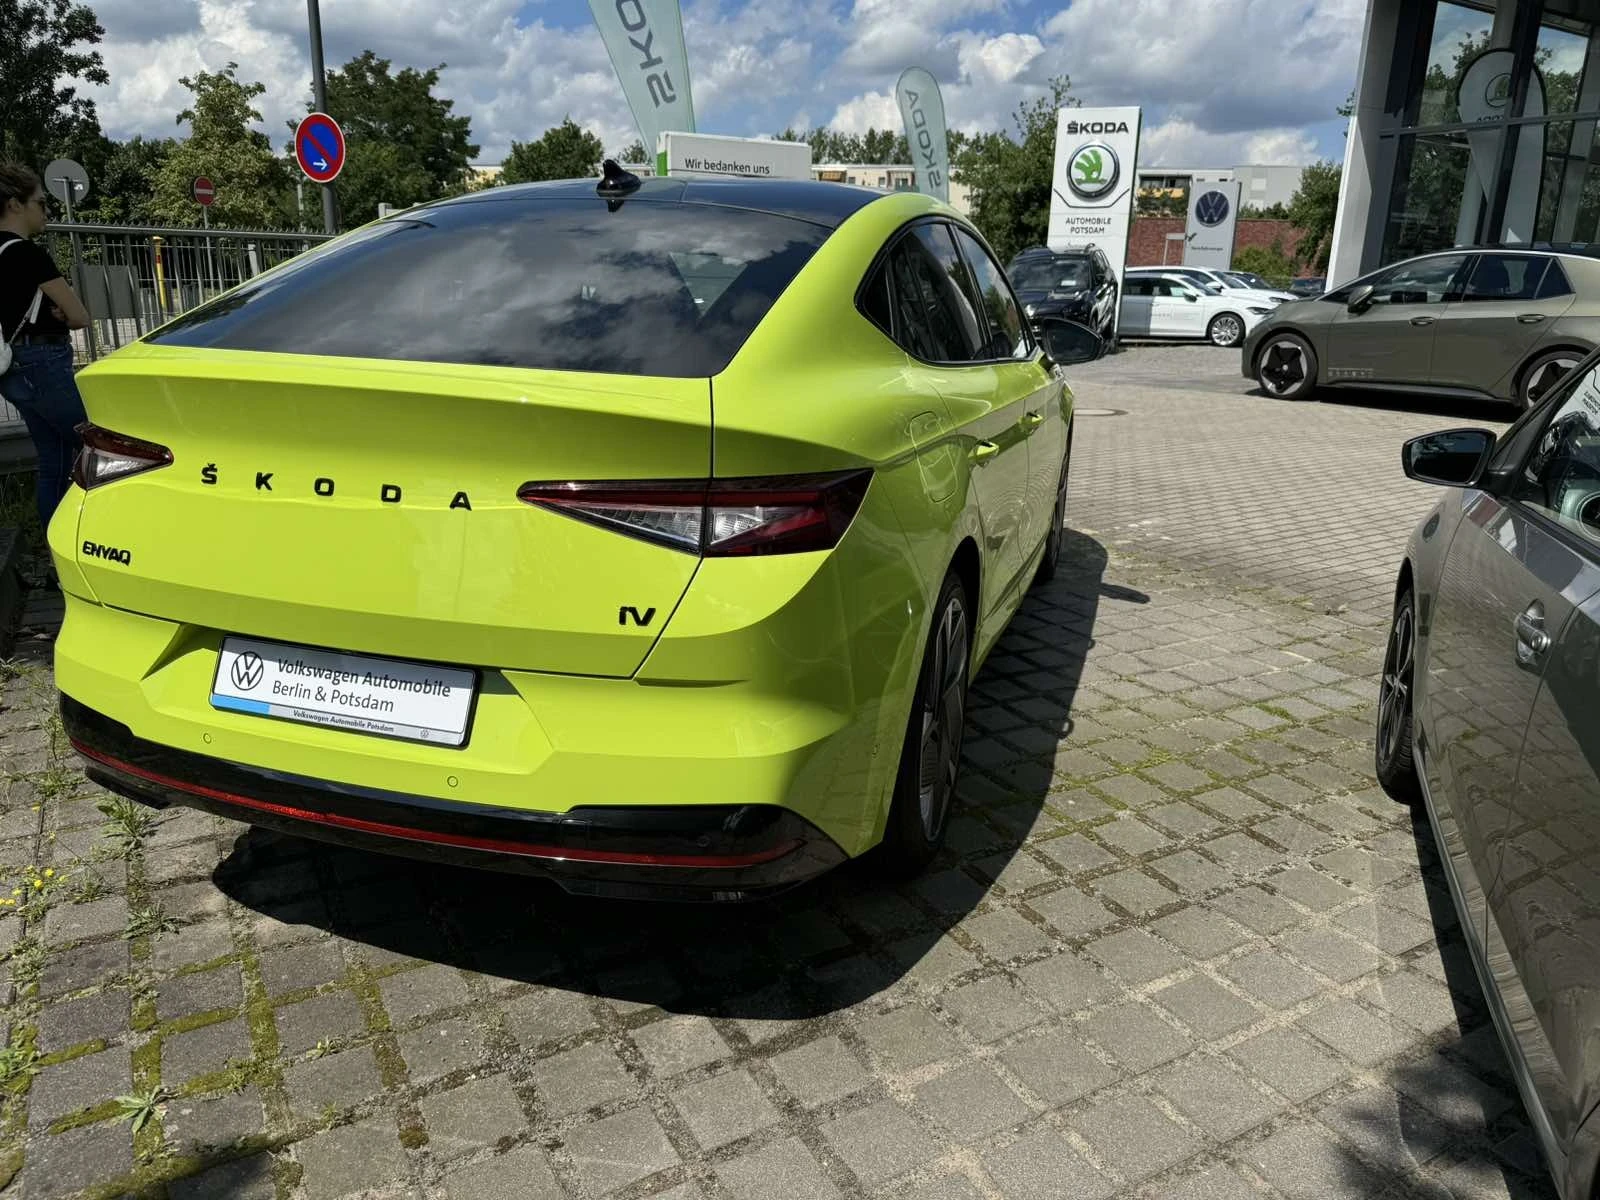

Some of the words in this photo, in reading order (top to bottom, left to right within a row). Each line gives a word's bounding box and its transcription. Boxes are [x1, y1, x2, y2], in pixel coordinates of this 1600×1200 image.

[1066, 120, 1129, 135] ŠKODA
[685, 158, 702, 169] Wir
[704, 160, 750, 173] bedanken
[753, 164, 770, 174] uns
[1066, 217, 1112, 225] AUTOMOBILE
[1070, 226, 1105, 234] POTSDAM
[83, 541, 131, 566] ENYAQ
[277, 658, 359, 685] Volkswagen
[362, 671, 451, 698] Automobile
[272, 681, 311, 700] Berlin
[314, 687, 327, 702] &
[331, 690, 394, 712] Potsdam
[293, 710, 329, 723] Volkswagen
[329, 716, 366, 728] Automobile
[367, 721, 394, 732] Potsdam
